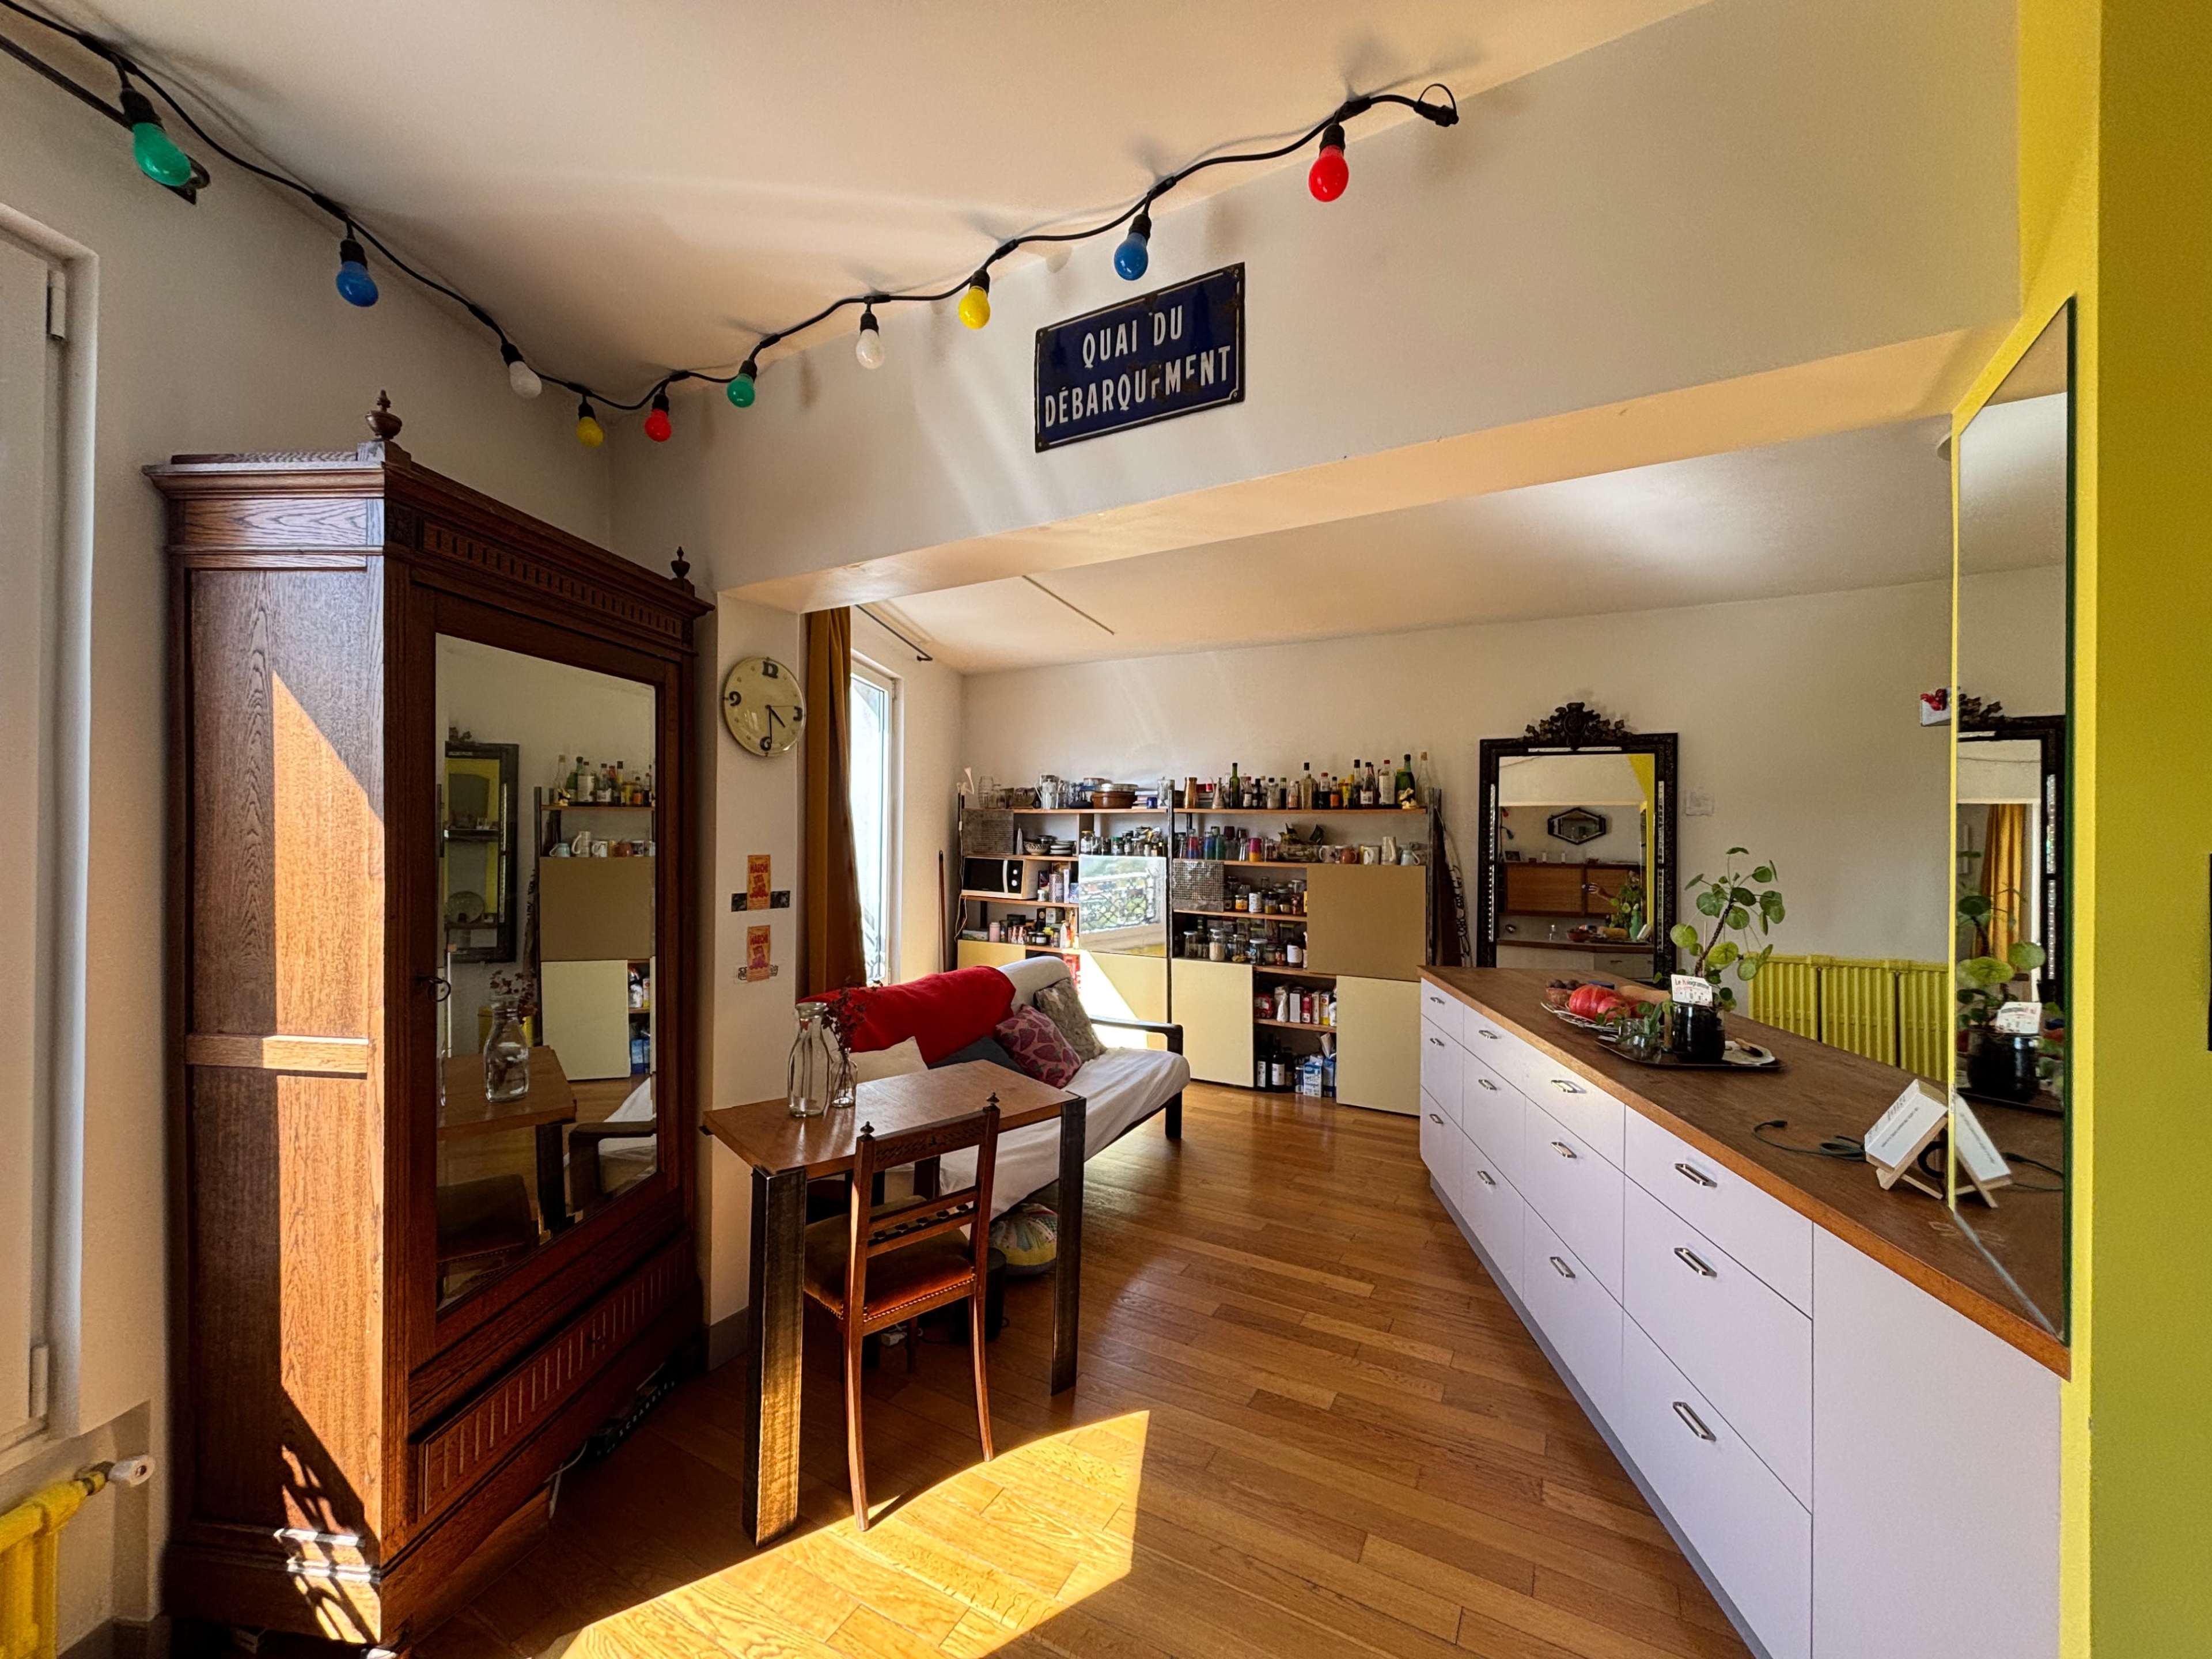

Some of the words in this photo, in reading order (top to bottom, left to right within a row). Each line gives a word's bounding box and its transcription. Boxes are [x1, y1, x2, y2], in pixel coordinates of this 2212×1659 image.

[1083, 320, 1137, 369] QUAI
[1154, 305, 1183, 346] DU
[729, 691, 741, 707] 9
[793, 706, 802, 722] 3
[760, 736, 772, 752] 6
